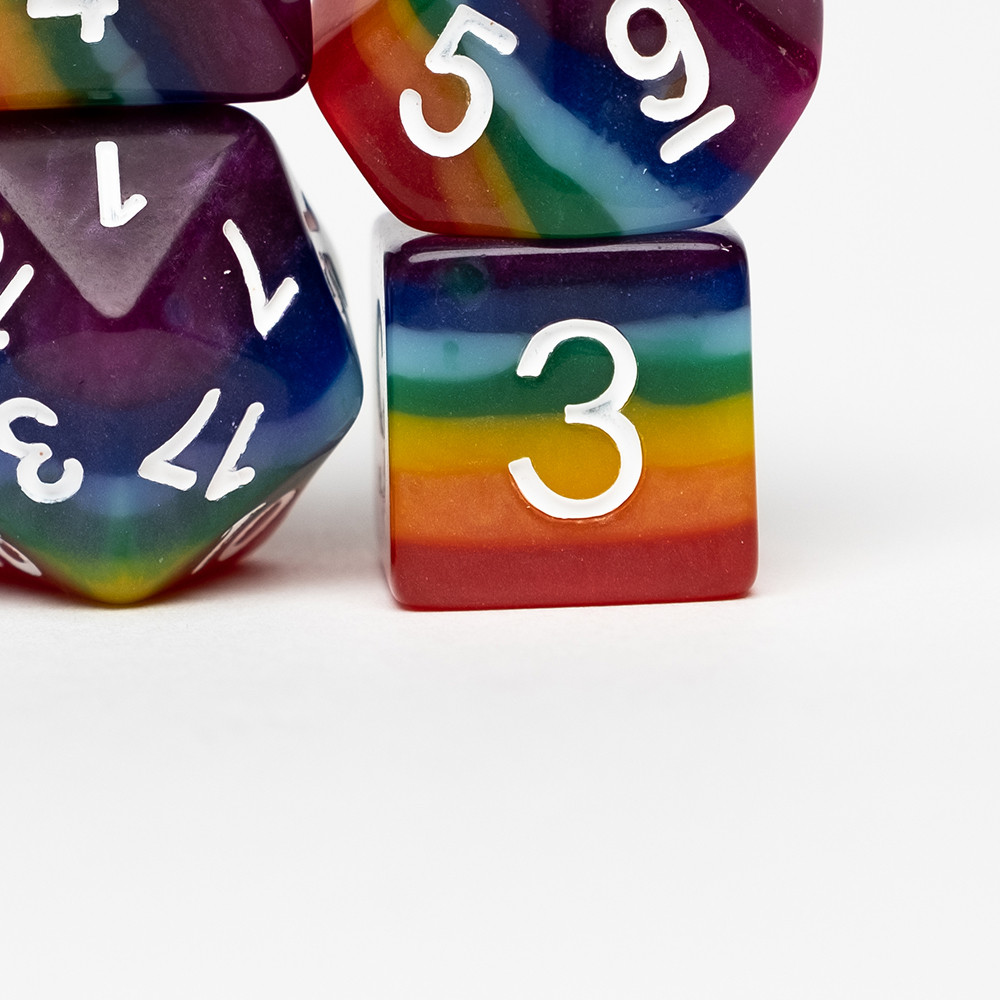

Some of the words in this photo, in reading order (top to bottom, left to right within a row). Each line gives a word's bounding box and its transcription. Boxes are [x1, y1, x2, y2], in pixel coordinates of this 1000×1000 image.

[399, 3, 518, 158] 5
[94, 140, 148, 228] 1
[137, 388, 265, 501] 17
[508, 318, 643, 520] 3
